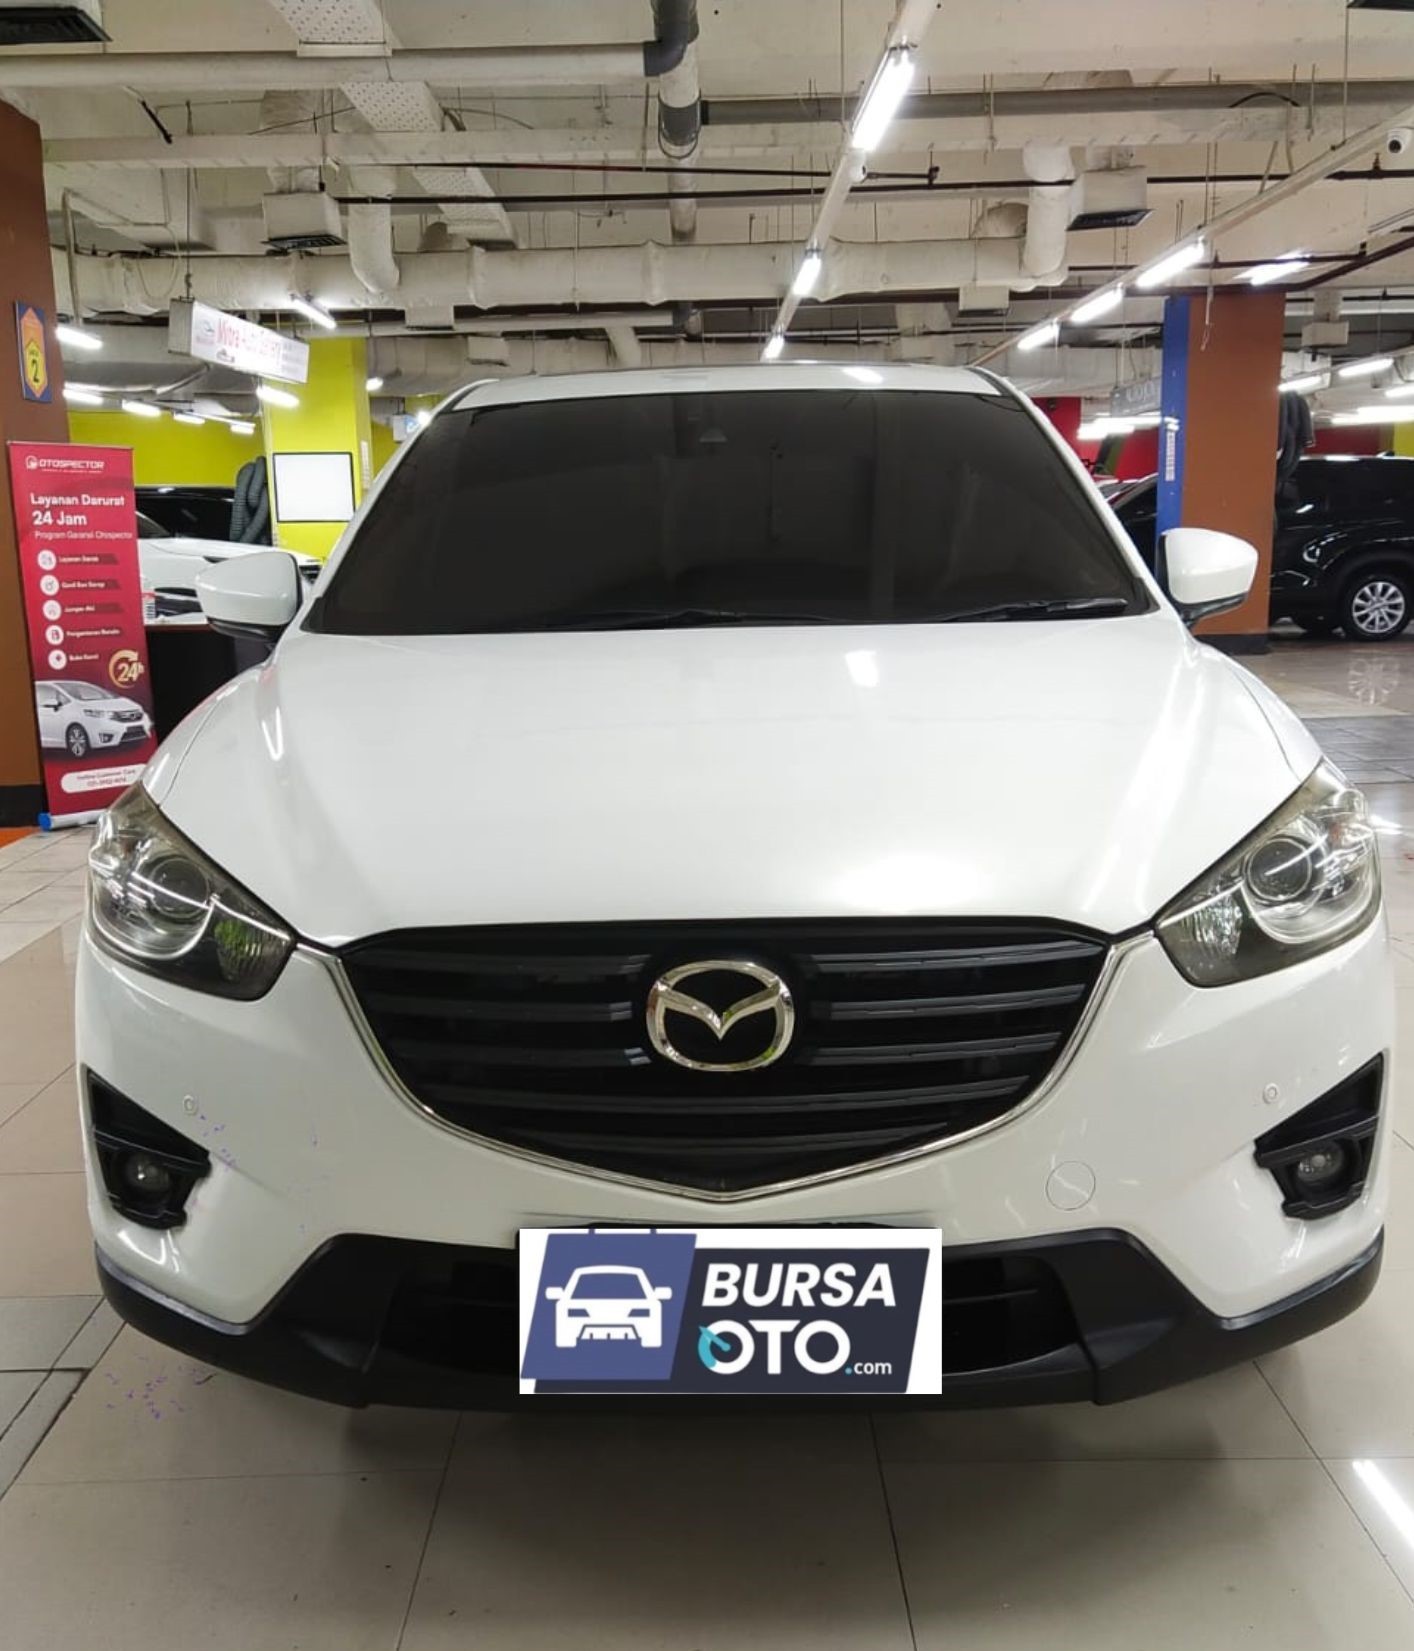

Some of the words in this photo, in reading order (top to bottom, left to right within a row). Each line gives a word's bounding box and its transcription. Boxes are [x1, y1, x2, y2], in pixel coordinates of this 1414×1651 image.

[31, 358, 40, 384] 2
[38, 458, 105, 469] OTOSPECTOR
[30, 492, 80, 508] Layanan
[80, 493, 125, 506] Darurat
[31, 510, 53, 526] 24
[56, 511, 88, 526] Jam
[34, 530, 66, 540] Program
